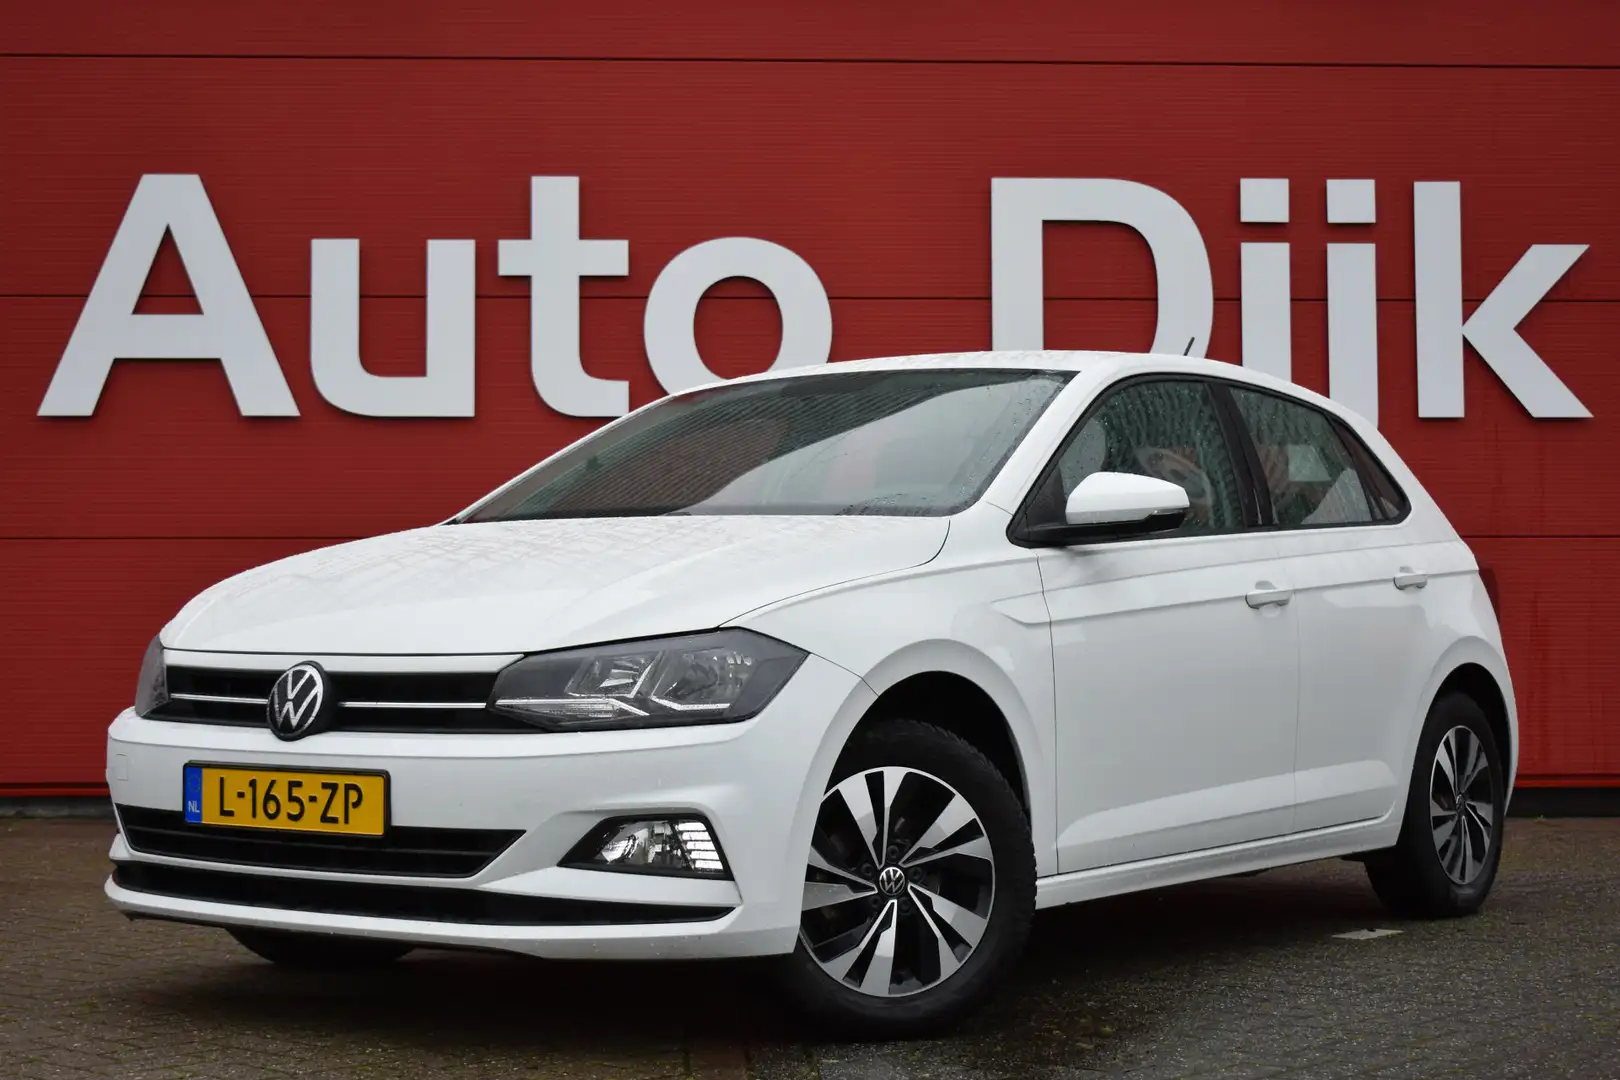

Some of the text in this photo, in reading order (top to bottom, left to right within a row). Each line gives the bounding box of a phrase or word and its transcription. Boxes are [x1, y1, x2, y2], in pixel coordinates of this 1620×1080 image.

[37, 174, 1593, 427] Auto Dijk
[188, 801, 200, 813] NL
[219, 776, 363, 825] L-165-ZP
